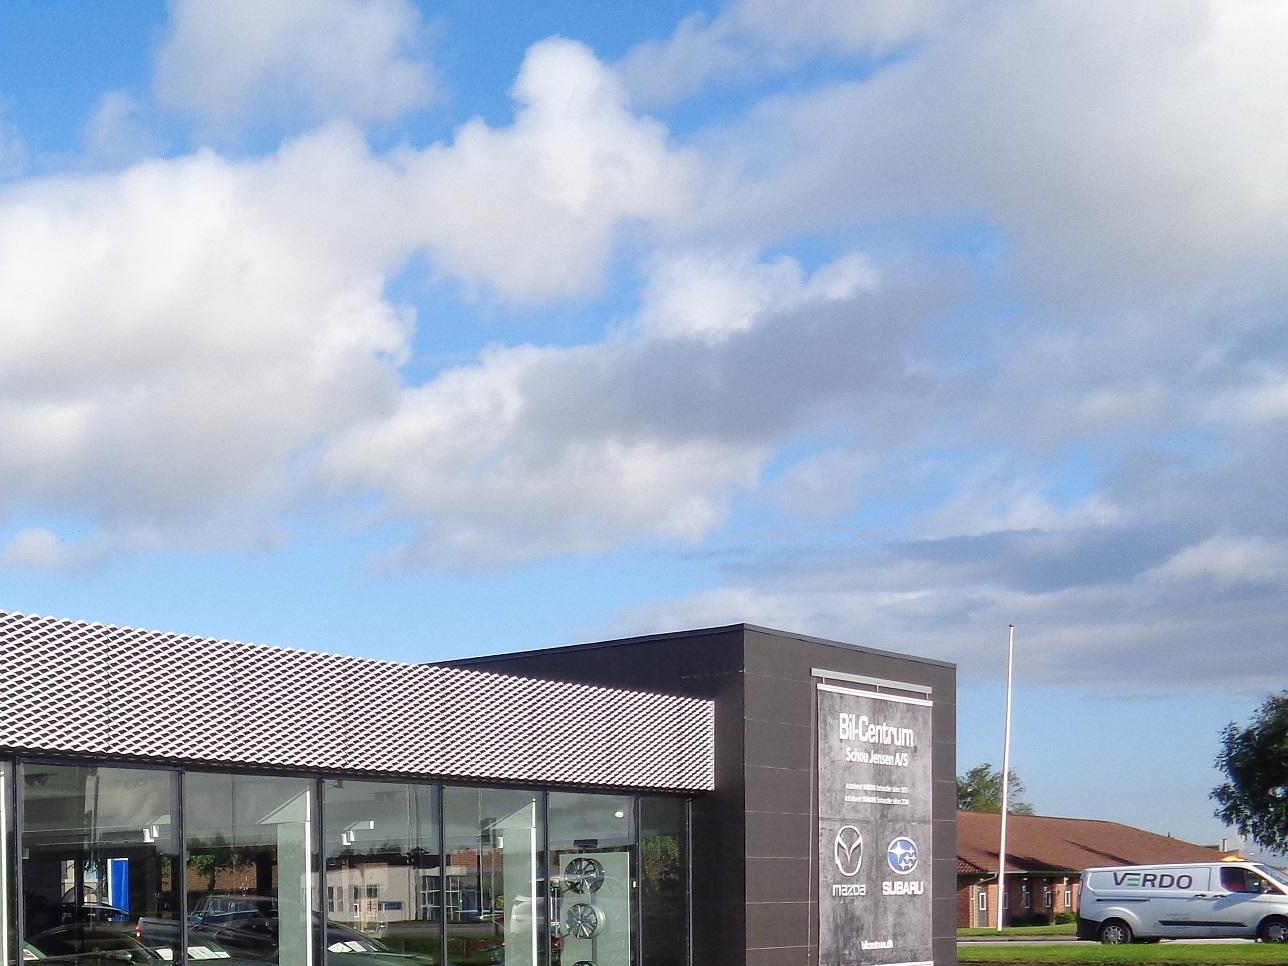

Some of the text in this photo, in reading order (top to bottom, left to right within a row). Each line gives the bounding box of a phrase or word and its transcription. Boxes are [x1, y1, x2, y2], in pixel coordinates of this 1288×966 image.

[839, 712, 914, 748] Bil-Centrum
[869, 749, 894, 766] Jensen
[894, 752, 909, 767] A/S
[882, 881, 923, 896] SUBARU
[1113, 872, 1193, 889] VERDO
